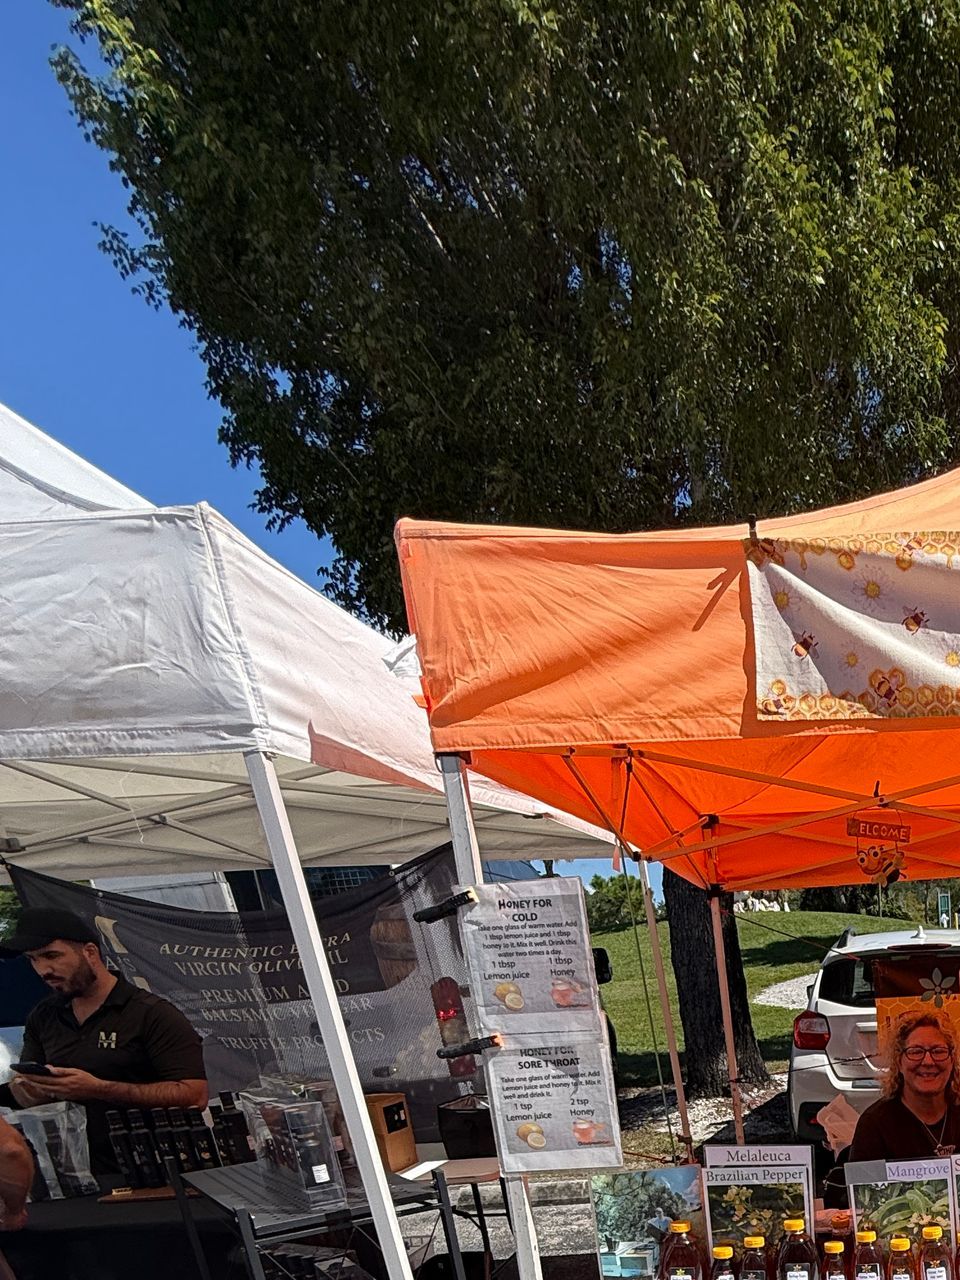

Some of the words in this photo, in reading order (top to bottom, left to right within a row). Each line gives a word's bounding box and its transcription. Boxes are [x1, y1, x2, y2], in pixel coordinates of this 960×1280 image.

[860, 823, 907, 840] ELCOME
[499, 899, 530, 909] HONEY
[534, 899, 552, 907] FOR
[512, 913, 538, 922] COLD
[505, 924, 519, 932] glass
[524, 931, 538, 939] juice
[160, 942, 283, 958] AUTHENTIC
[289, 932, 351, 955] ERA
[498, 960, 515, 969] tbsp
[555, 957, 572, 966] tbsp
[174, 961, 244, 977] VIRGIN
[551, 969, 575, 978] Honey
[484, 972, 510, 981] Lemon
[511, 971, 530, 981] juice
[200, 986, 290, 1002] PREMIUM
[299, 979, 350, 998] AD
[202, 1007, 287, 1022] BALSAMIC
[218, 1036, 290, 1052] TRUFFLE
[292, 1027, 385, 1048] PROCTS
[518, 1061, 542, 1069] SORE
[545, 1057, 580, 1067] THROAT
[524, 1083, 538, 1091] juice
[520, 1103, 532, 1111] tsp
[577, 1098, 588, 1107] tsp
[534, 1112, 552, 1122] juice
[570, 1109, 595, 1117] Honey
[726, 1150, 792, 1163] Melaleuca
[706, 1169, 759, 1183] Brazilian
[762, 1169, 804, 1183] Pepper
[887, 1163, 949, 1179] Mangrove
